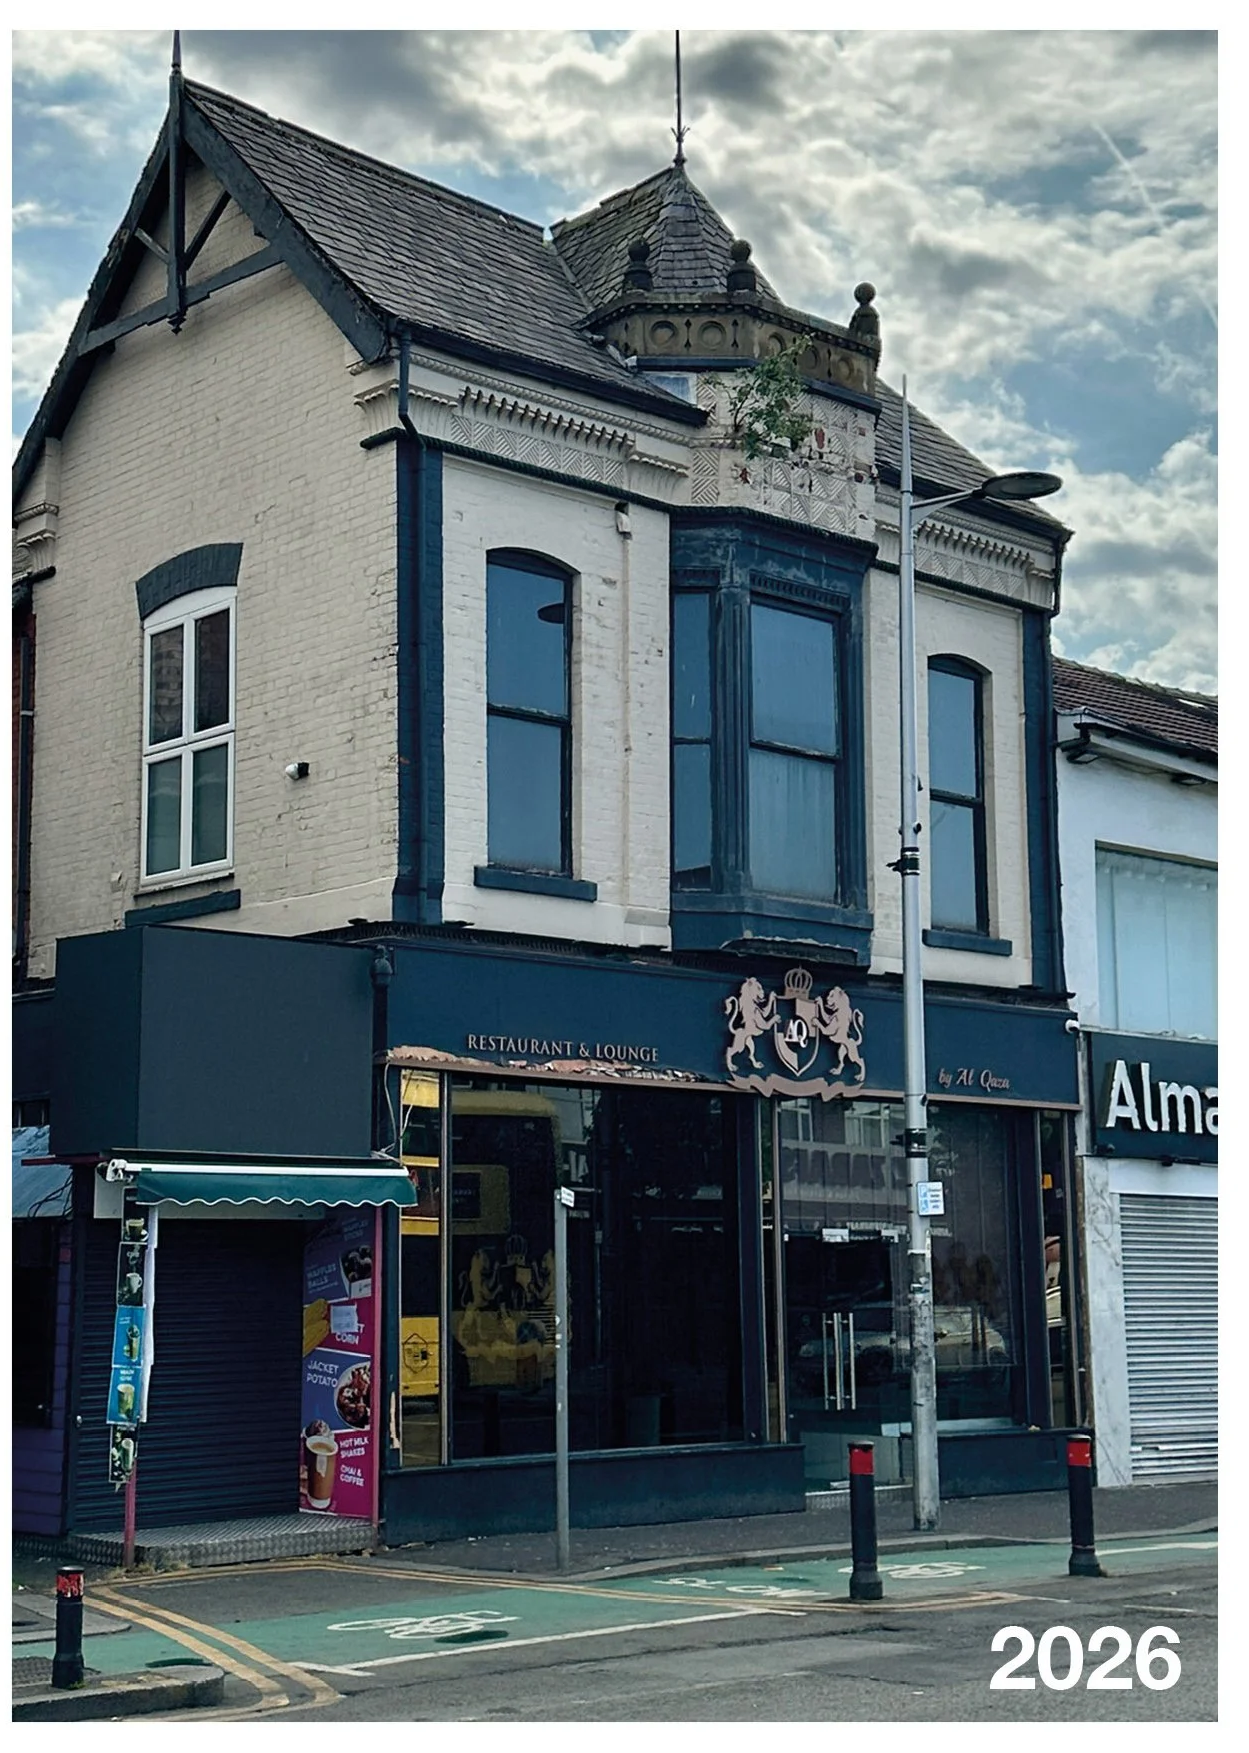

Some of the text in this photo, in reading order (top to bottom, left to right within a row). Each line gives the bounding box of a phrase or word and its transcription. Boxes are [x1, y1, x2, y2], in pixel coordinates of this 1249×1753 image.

[784, 1019, 808, 1048] AQ
[468, 1033, 659, 1063] RESTAURANT & LOUNGE
[939, 1068, 953, 1089] by
[956, 1068, 975, 1086] Al
[307, 1360, 339, 1375] JACKET
[306, 1373, 338, 1388] POTATO
[340, 1438, 352, 1449] HOT
[340, 1473, 364, 1487] COFFEE
